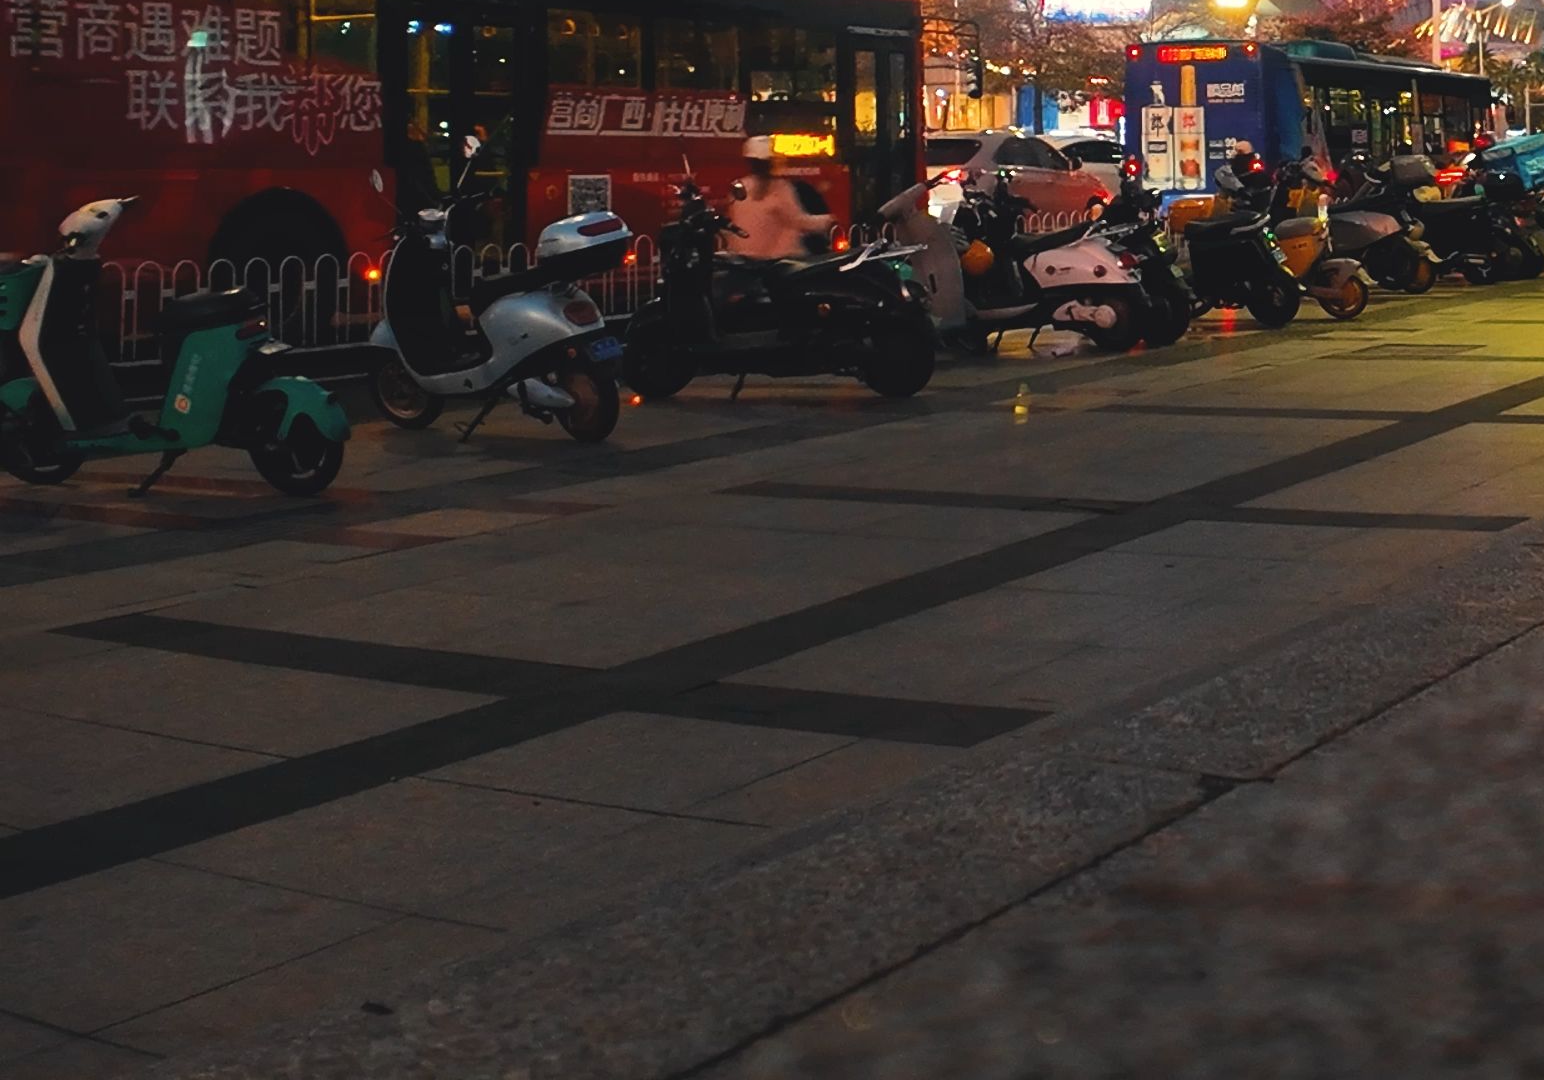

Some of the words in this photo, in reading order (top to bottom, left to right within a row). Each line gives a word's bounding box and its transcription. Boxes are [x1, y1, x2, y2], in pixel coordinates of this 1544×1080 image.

[126, 66, 382, 156] 联系我帮您
